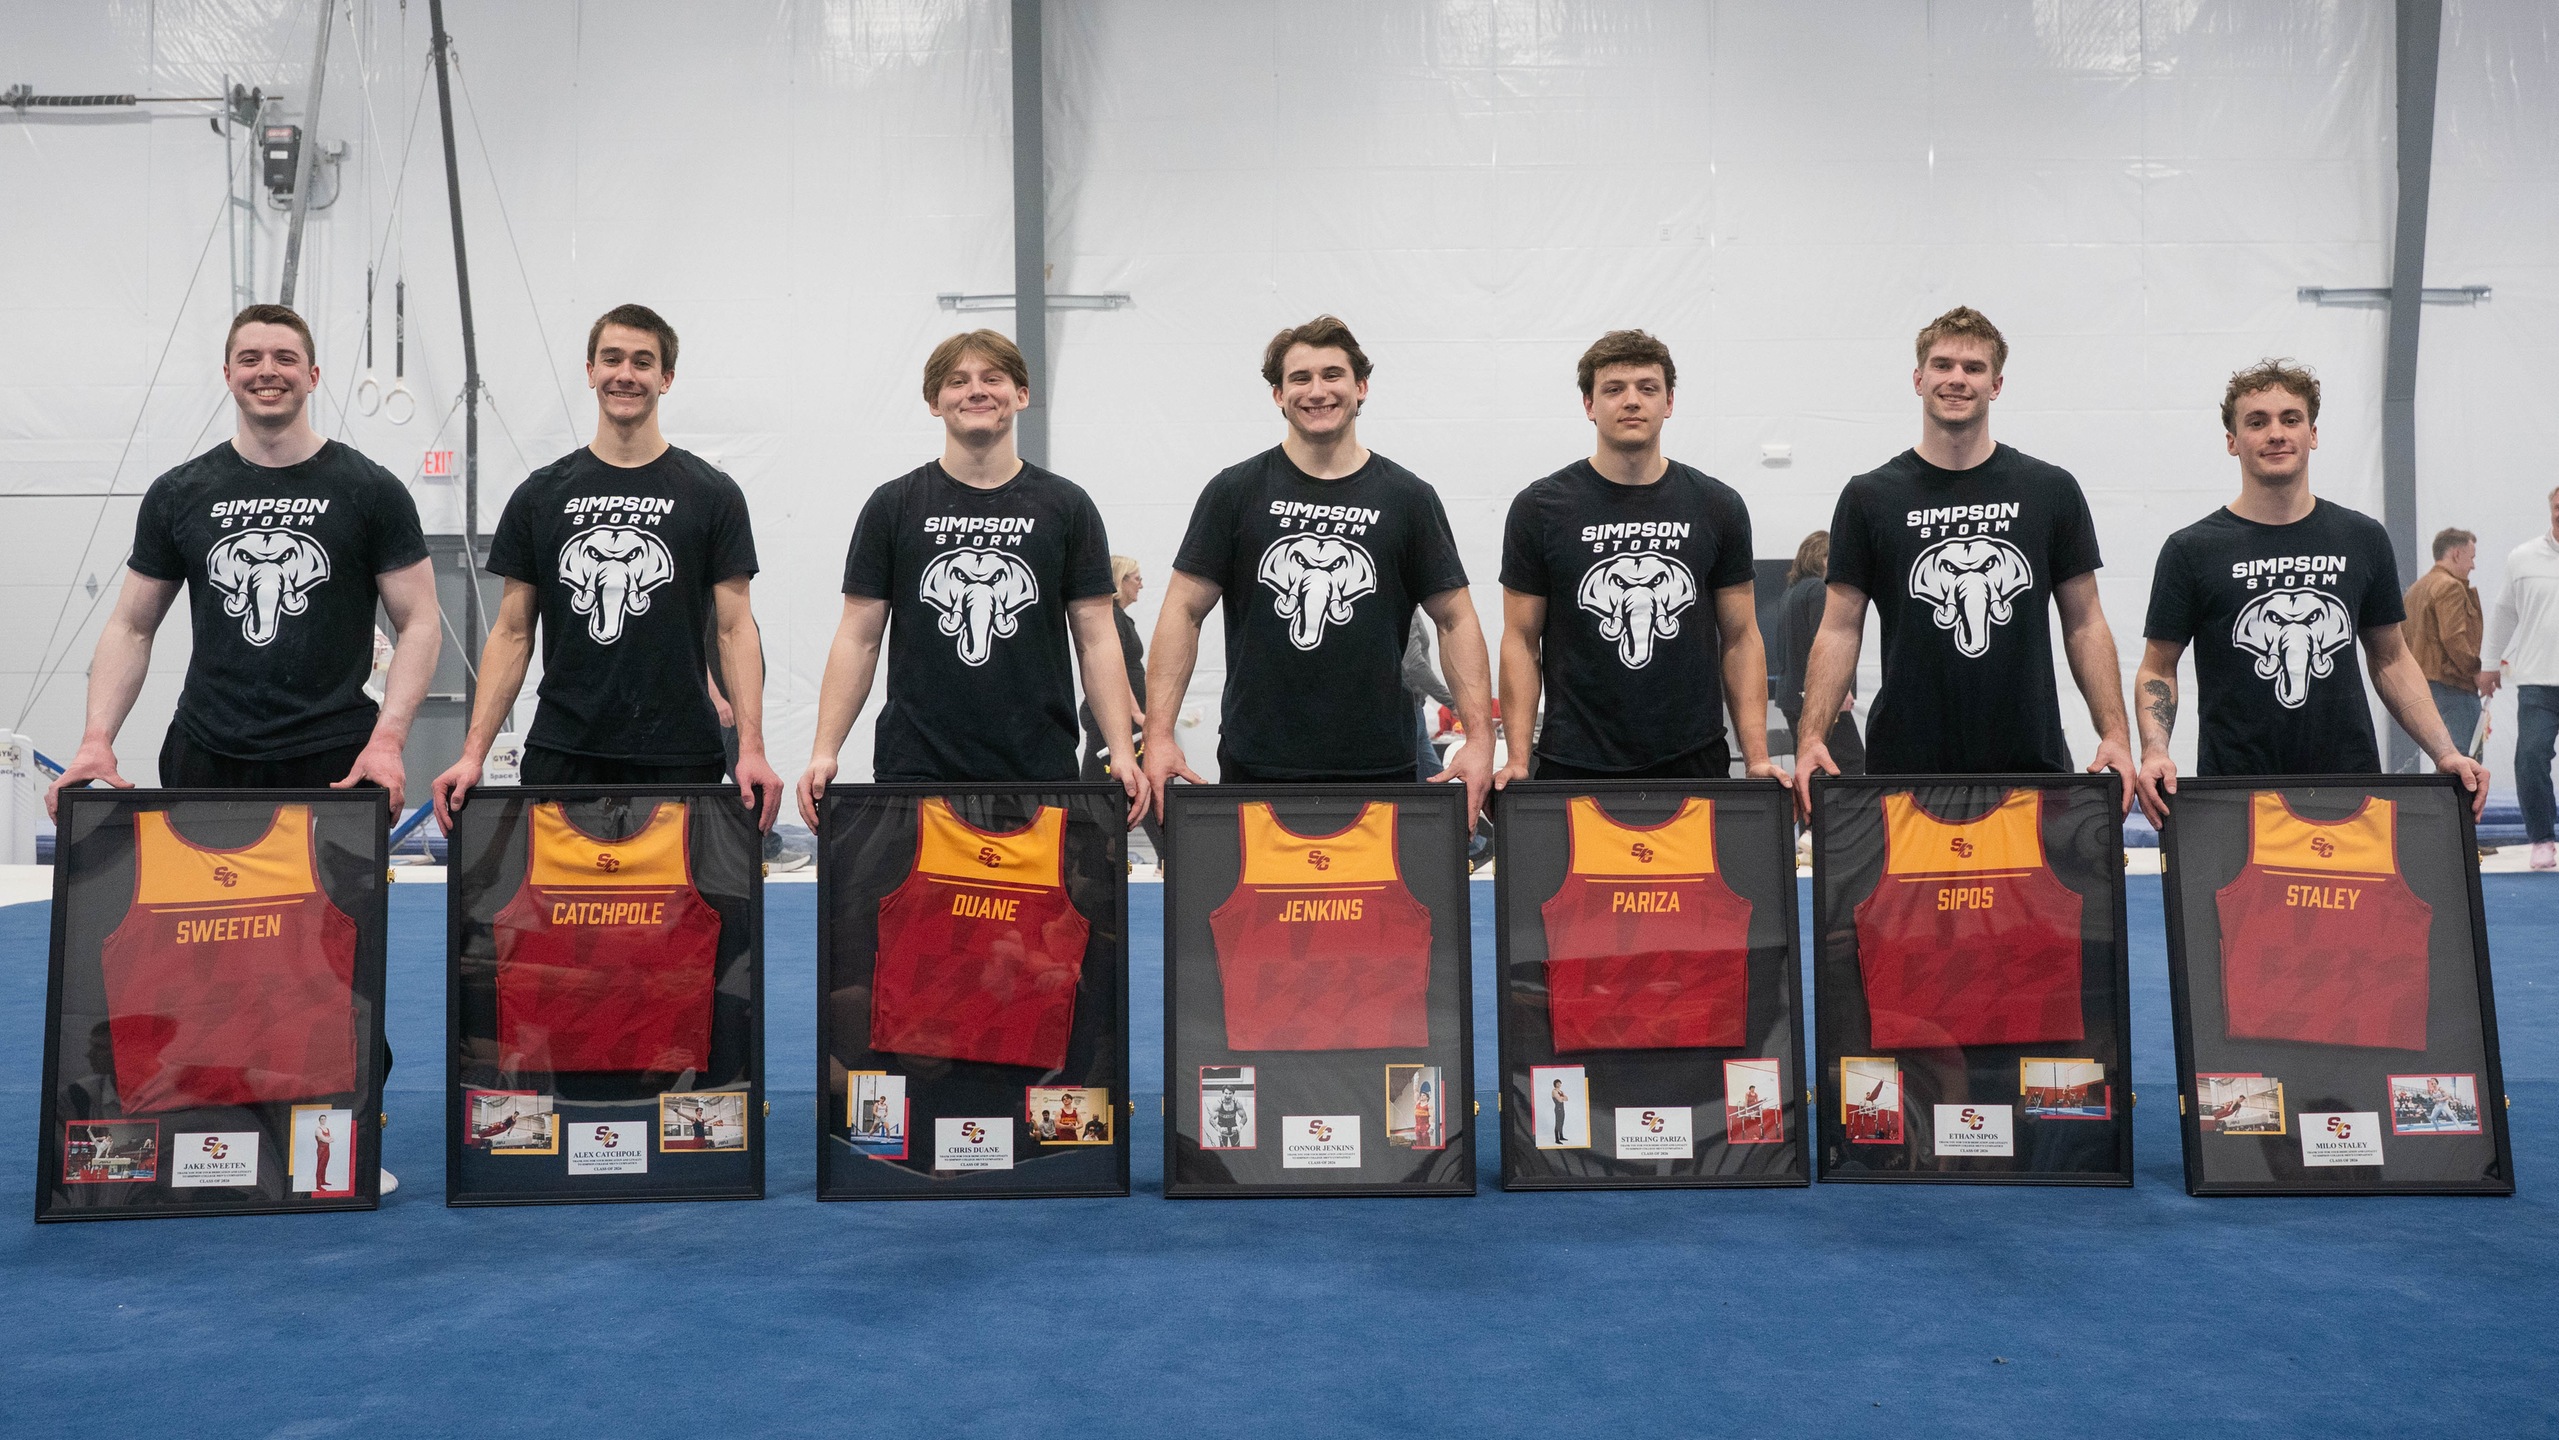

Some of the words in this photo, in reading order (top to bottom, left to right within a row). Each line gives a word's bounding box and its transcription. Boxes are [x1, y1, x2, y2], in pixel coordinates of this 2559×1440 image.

[424, 451, 454, 474] EXIT
[211, 499, 329, 517] SIMPSON
[564, 497, 674, 514] SIMPSON
[1270, 501, 1380, 524] SIMPSON
[1907, 503, 2019, 526] SIMPSON
[221, 515, 315, 528] STORM
[573, 513, 661, 525] STORM
[924, 517, 1035, 533] SIMPSON
[1280, 518, 1367, 535] STORM
[1921, 522, 2009, 538] STORM
[936, 534, 1022, 546] STORM
[1581, 522, 1690, 541] SIMPSON
[1593, 539, 1680, 553] STORM
[2232, 556, 2346, 578] SIMPSON
[2247, 574, 2337, 589] STORM
[951, 893, 1020, 922] DUANE
[1612, 891, 1681, 913] PARIZA
[1937, 886, 1994, 911] SIPOS
[2286, 884, 2361, 910] STALEY
[551, 902, 665, 925] CATCHPOLE
[1279, 898, 1364, 922] JENKINS
[176, 914, 281, 944] SWEETEN
[1641, 1111, 1665, 1133] SC
[1960, 1108, 1985, 1130] SC
[2326, 1116, 2351, 1140] SC
[594, 1125, 619, 1148] SC
[961, 1121, 986, 1144] SC
[1308, 1119, 1333, 1142] SC
[202, 1136, 229, 1160] SC
[573, 1151, 594, 1159] ALEX
[595, 1150, 642, 1158] CATCHPOLE
